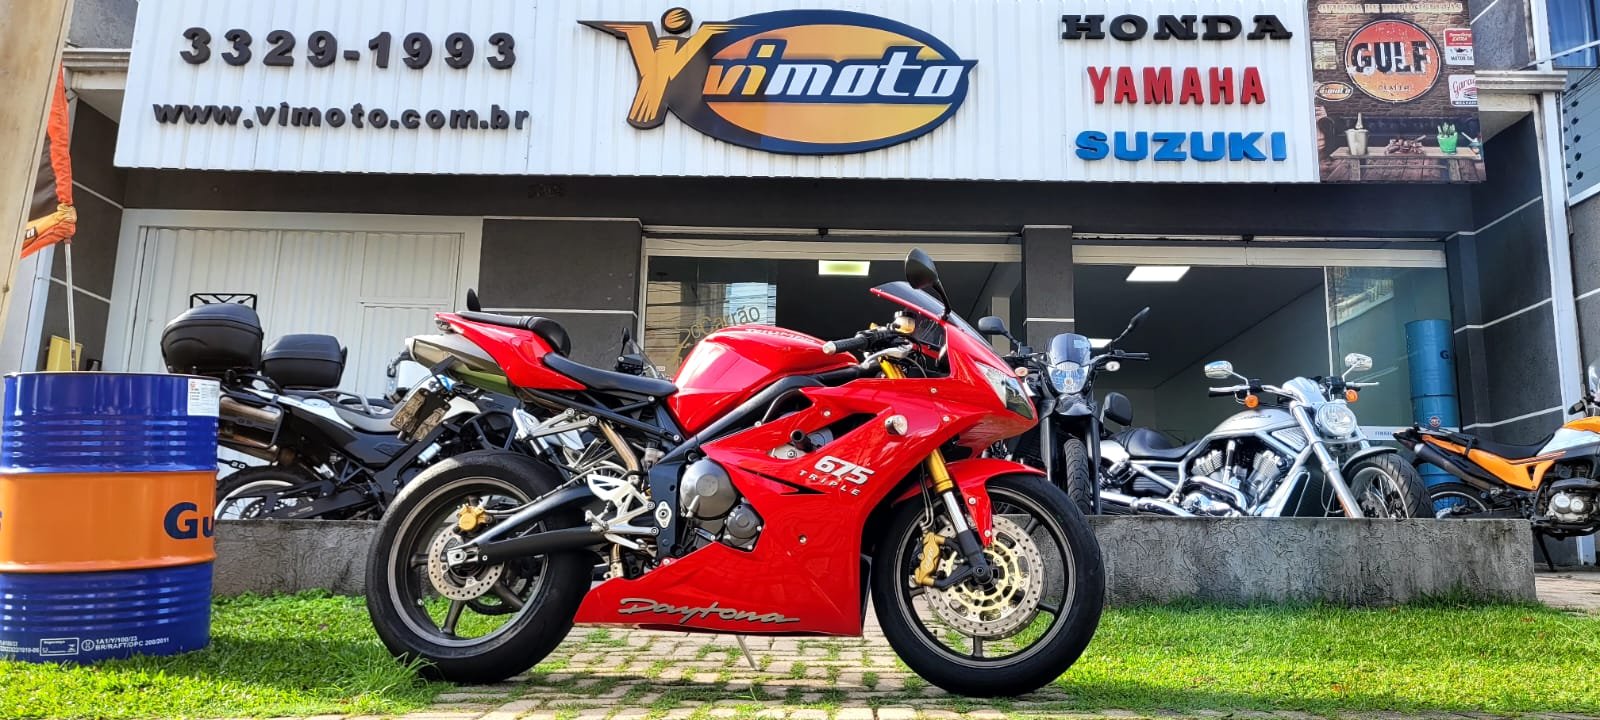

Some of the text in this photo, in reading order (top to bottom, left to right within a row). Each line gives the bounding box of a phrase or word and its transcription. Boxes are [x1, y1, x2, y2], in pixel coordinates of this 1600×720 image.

[1061, 14, 1293, 41] HONDA
[179, 27, 517, 70] 3329-1993
[1351, 41, 1431, 75] GULF
[702, 44, 965, 97] vimoto
[1087, 66, 1266, 105] YAMAHA
[153, 102, 530, 131] www.vimoto.com.br
[1075, 131, 1287, 161] SUZUKI
[799, 469, 860, 496] TRIPLE
[814, 455, 875, 485] 675
[618, 597, 801, 623] Daytona
